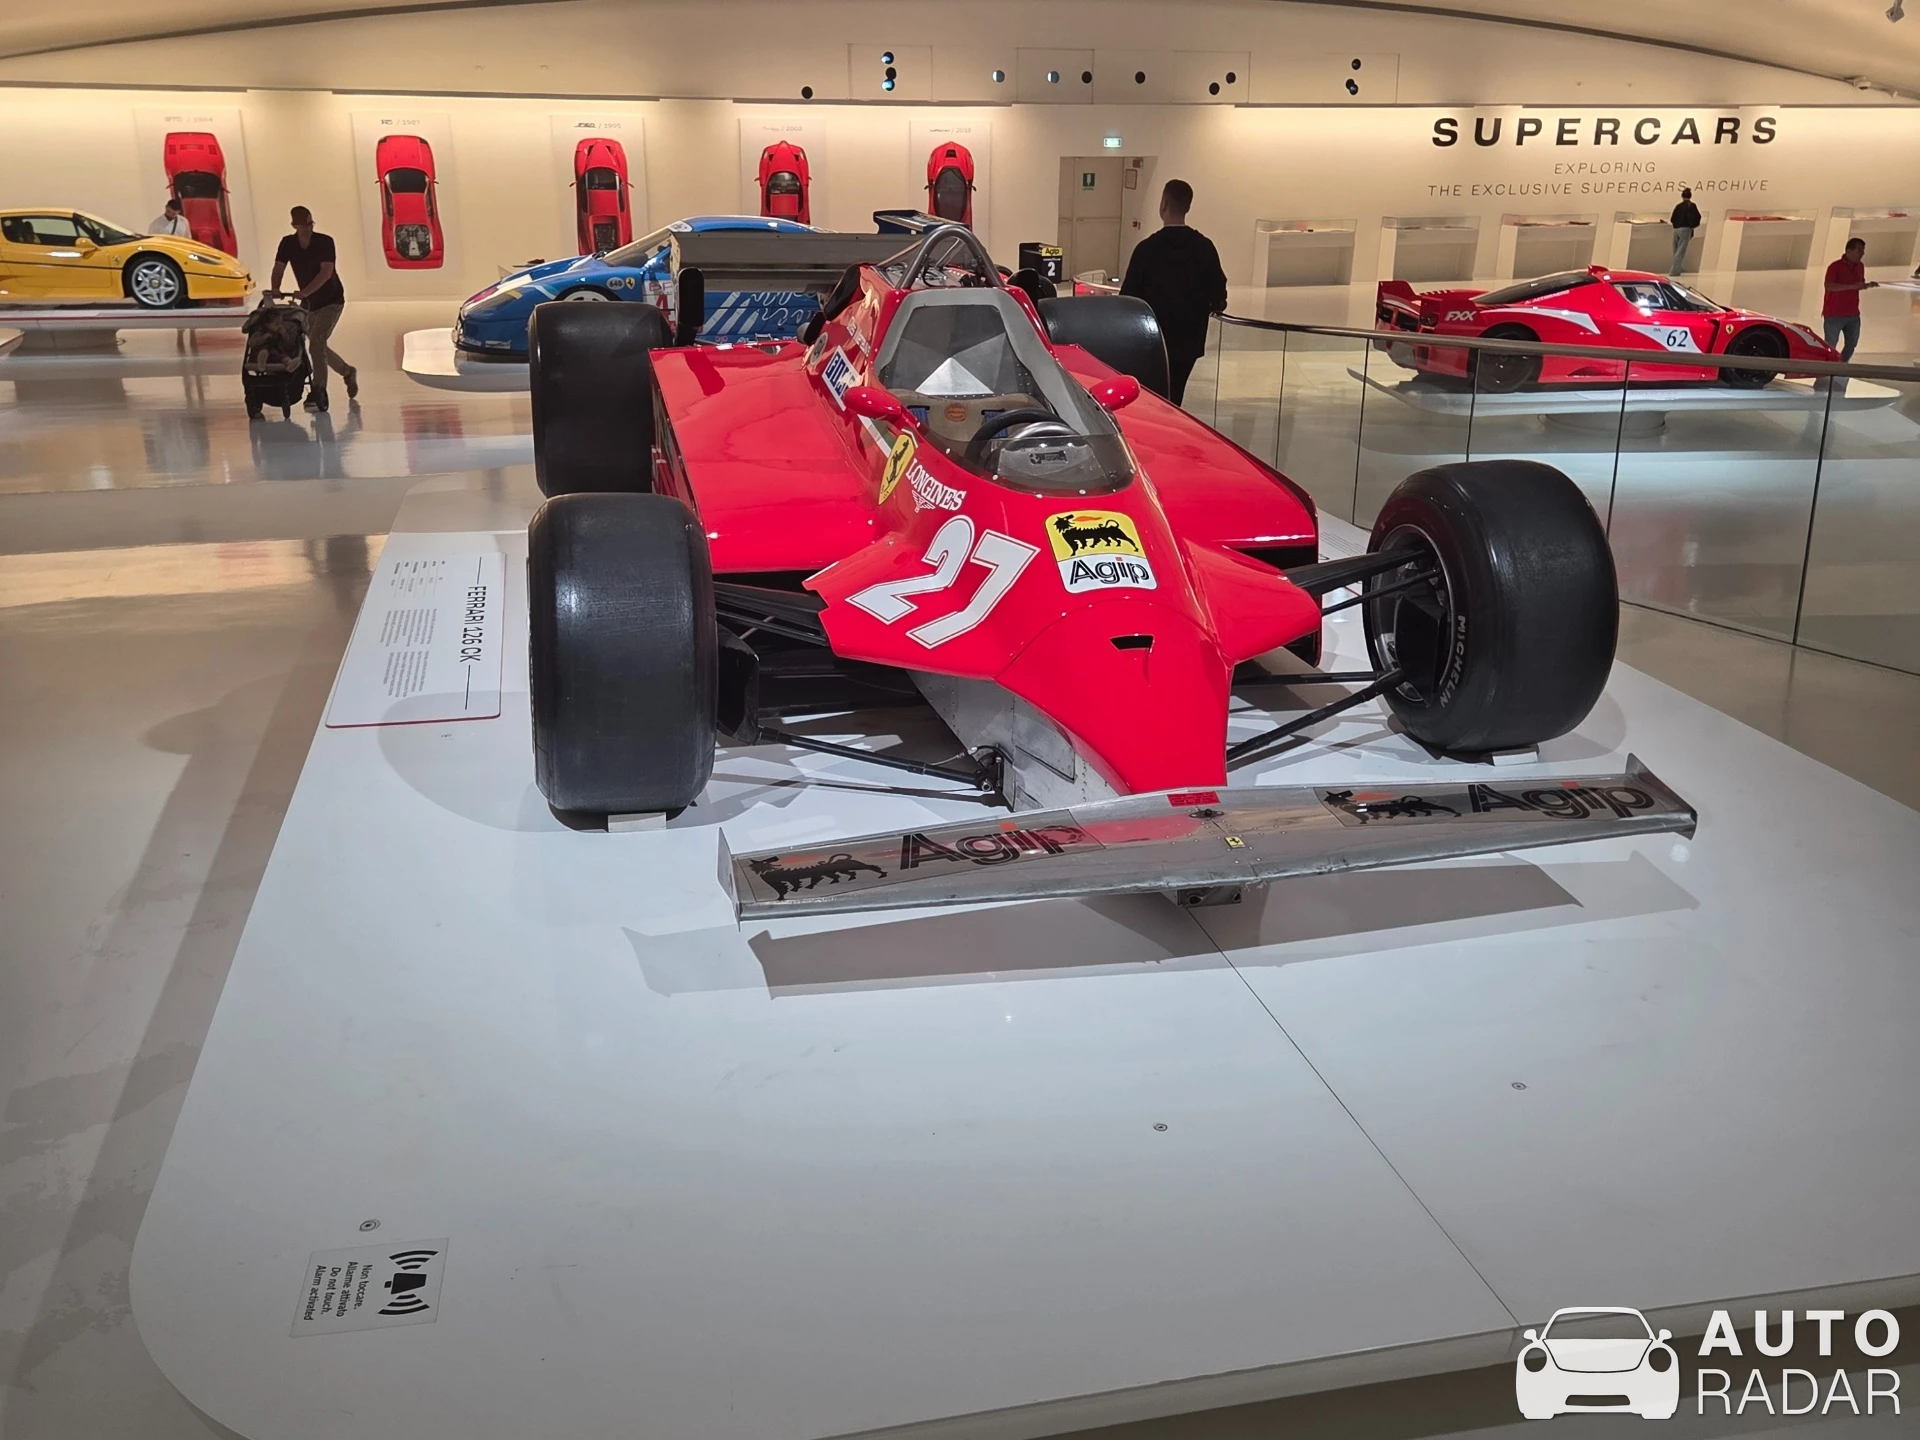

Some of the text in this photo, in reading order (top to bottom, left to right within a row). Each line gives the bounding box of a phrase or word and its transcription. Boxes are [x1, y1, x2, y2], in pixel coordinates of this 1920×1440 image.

[1431, 117, 1777, 147] SUPERCARS
[1427, 179, 1769, 197] THE EXCLUSIVE SUPERCARS ARCHIVE
[1554, 161, 1657, 175] EXPLORING
[649, 282, 673, 291] BF
[1047, 261, 1056, 277] 2
[1445, 311, 1477, 321] FXX
[1666, 329, 1689, 348] 62
[905, 457, 967, 511] LONGINES
[845, 514, 1041, 650] 27
[1069, 556, 1150, 585] Agip
[459, 585, 487, 663] FERRARI 126 CK
[1440, 615, 1466, 708] MICHELIN
[1466, 781, 1656, 819] Agip
[900, 822, 1087, 870] Agip
[304, 1265, 327, 1321] Alarm activated
[320, 1267, 341, 1315] Do not touch.
[336, 1261, 358, 1317] Allarme attivato
[353, 1264, 373, 1310] Non toccare.
